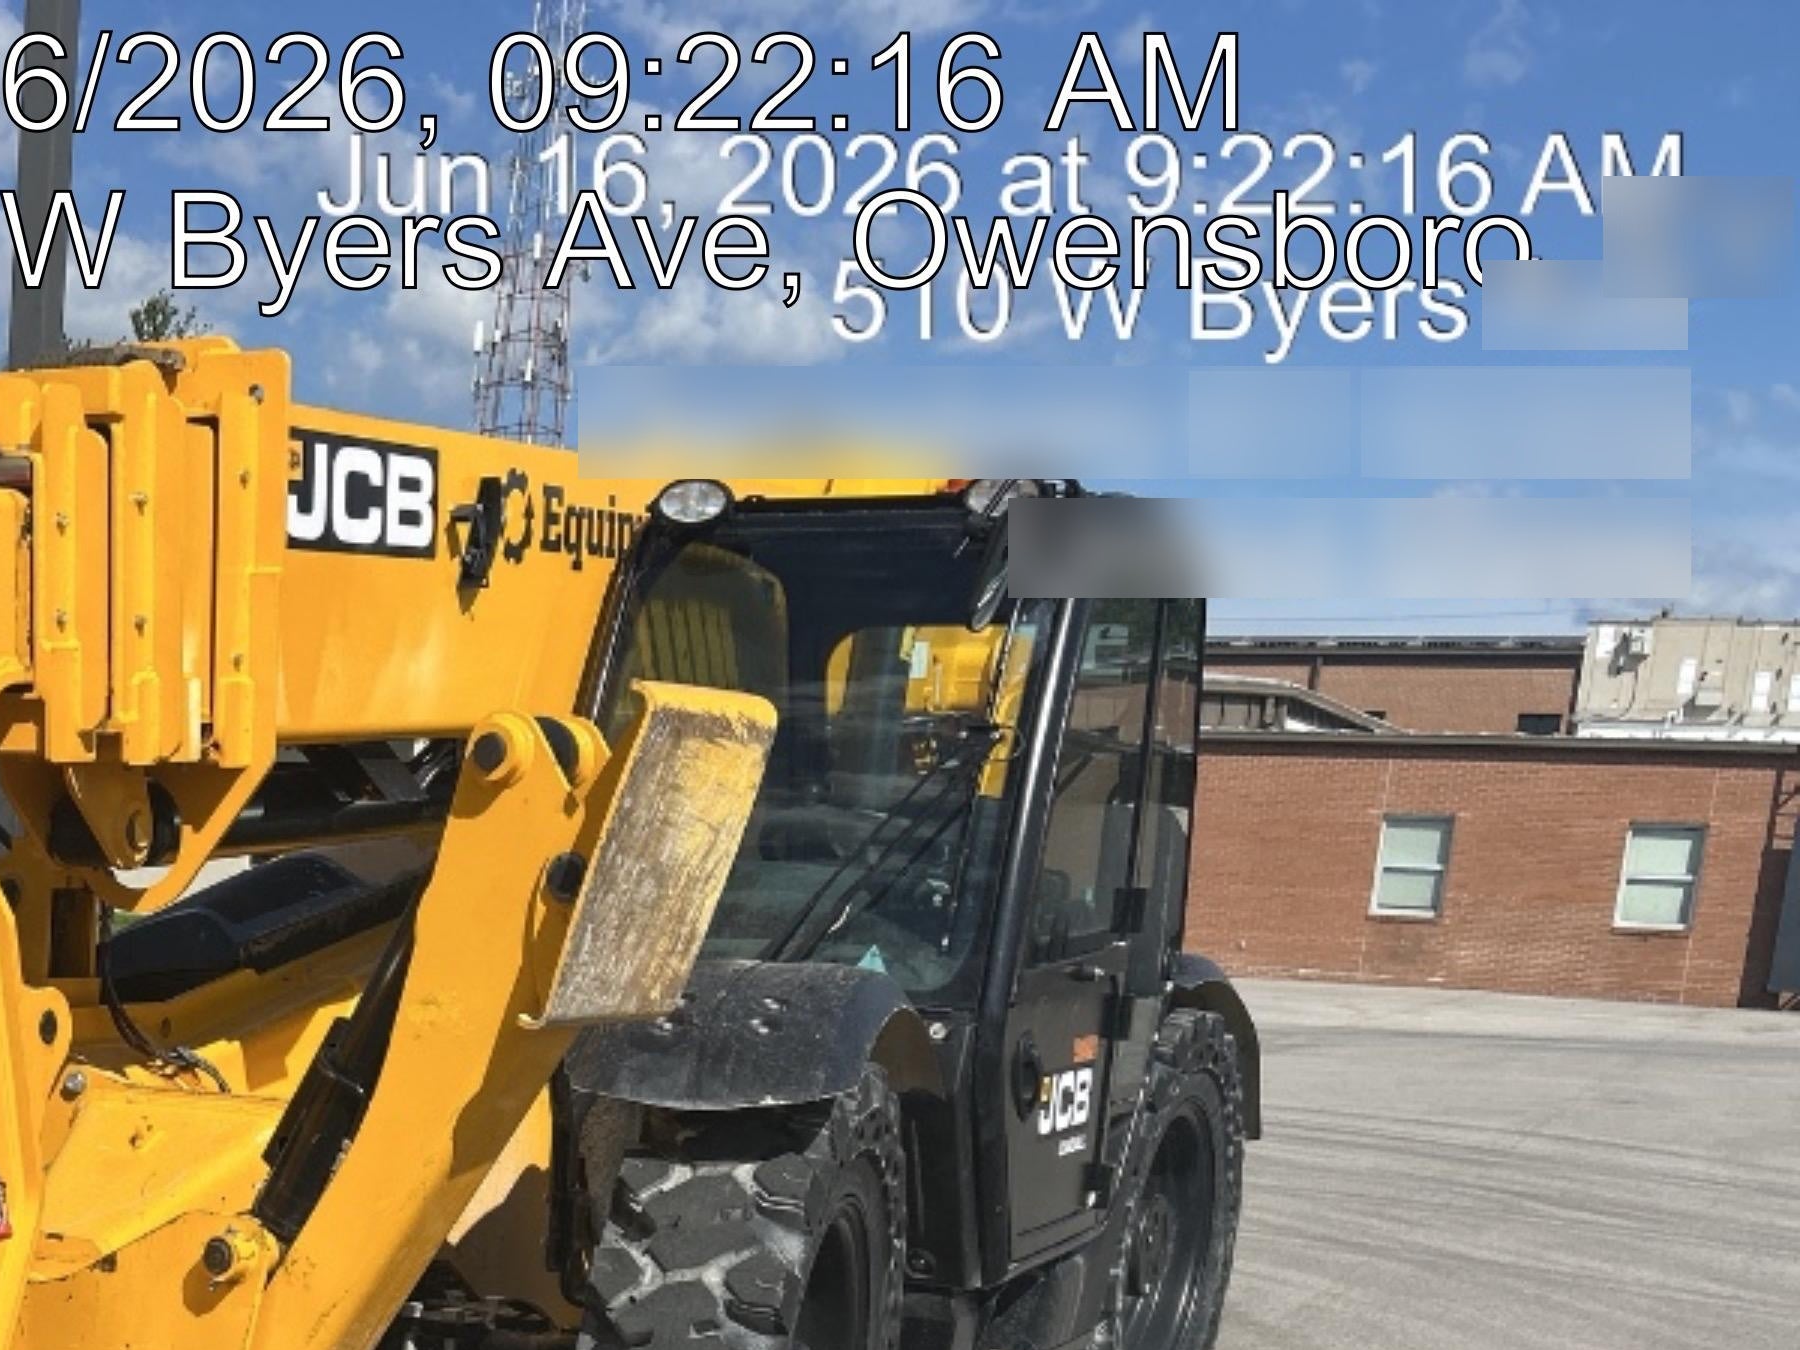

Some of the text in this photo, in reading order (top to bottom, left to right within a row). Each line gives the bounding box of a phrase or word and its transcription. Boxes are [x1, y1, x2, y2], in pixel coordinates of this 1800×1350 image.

[286, 442, 435, 549] JCB
[540, 484, 646, 572] Equip
[1038, 1067, 1093, 1135] JCB
